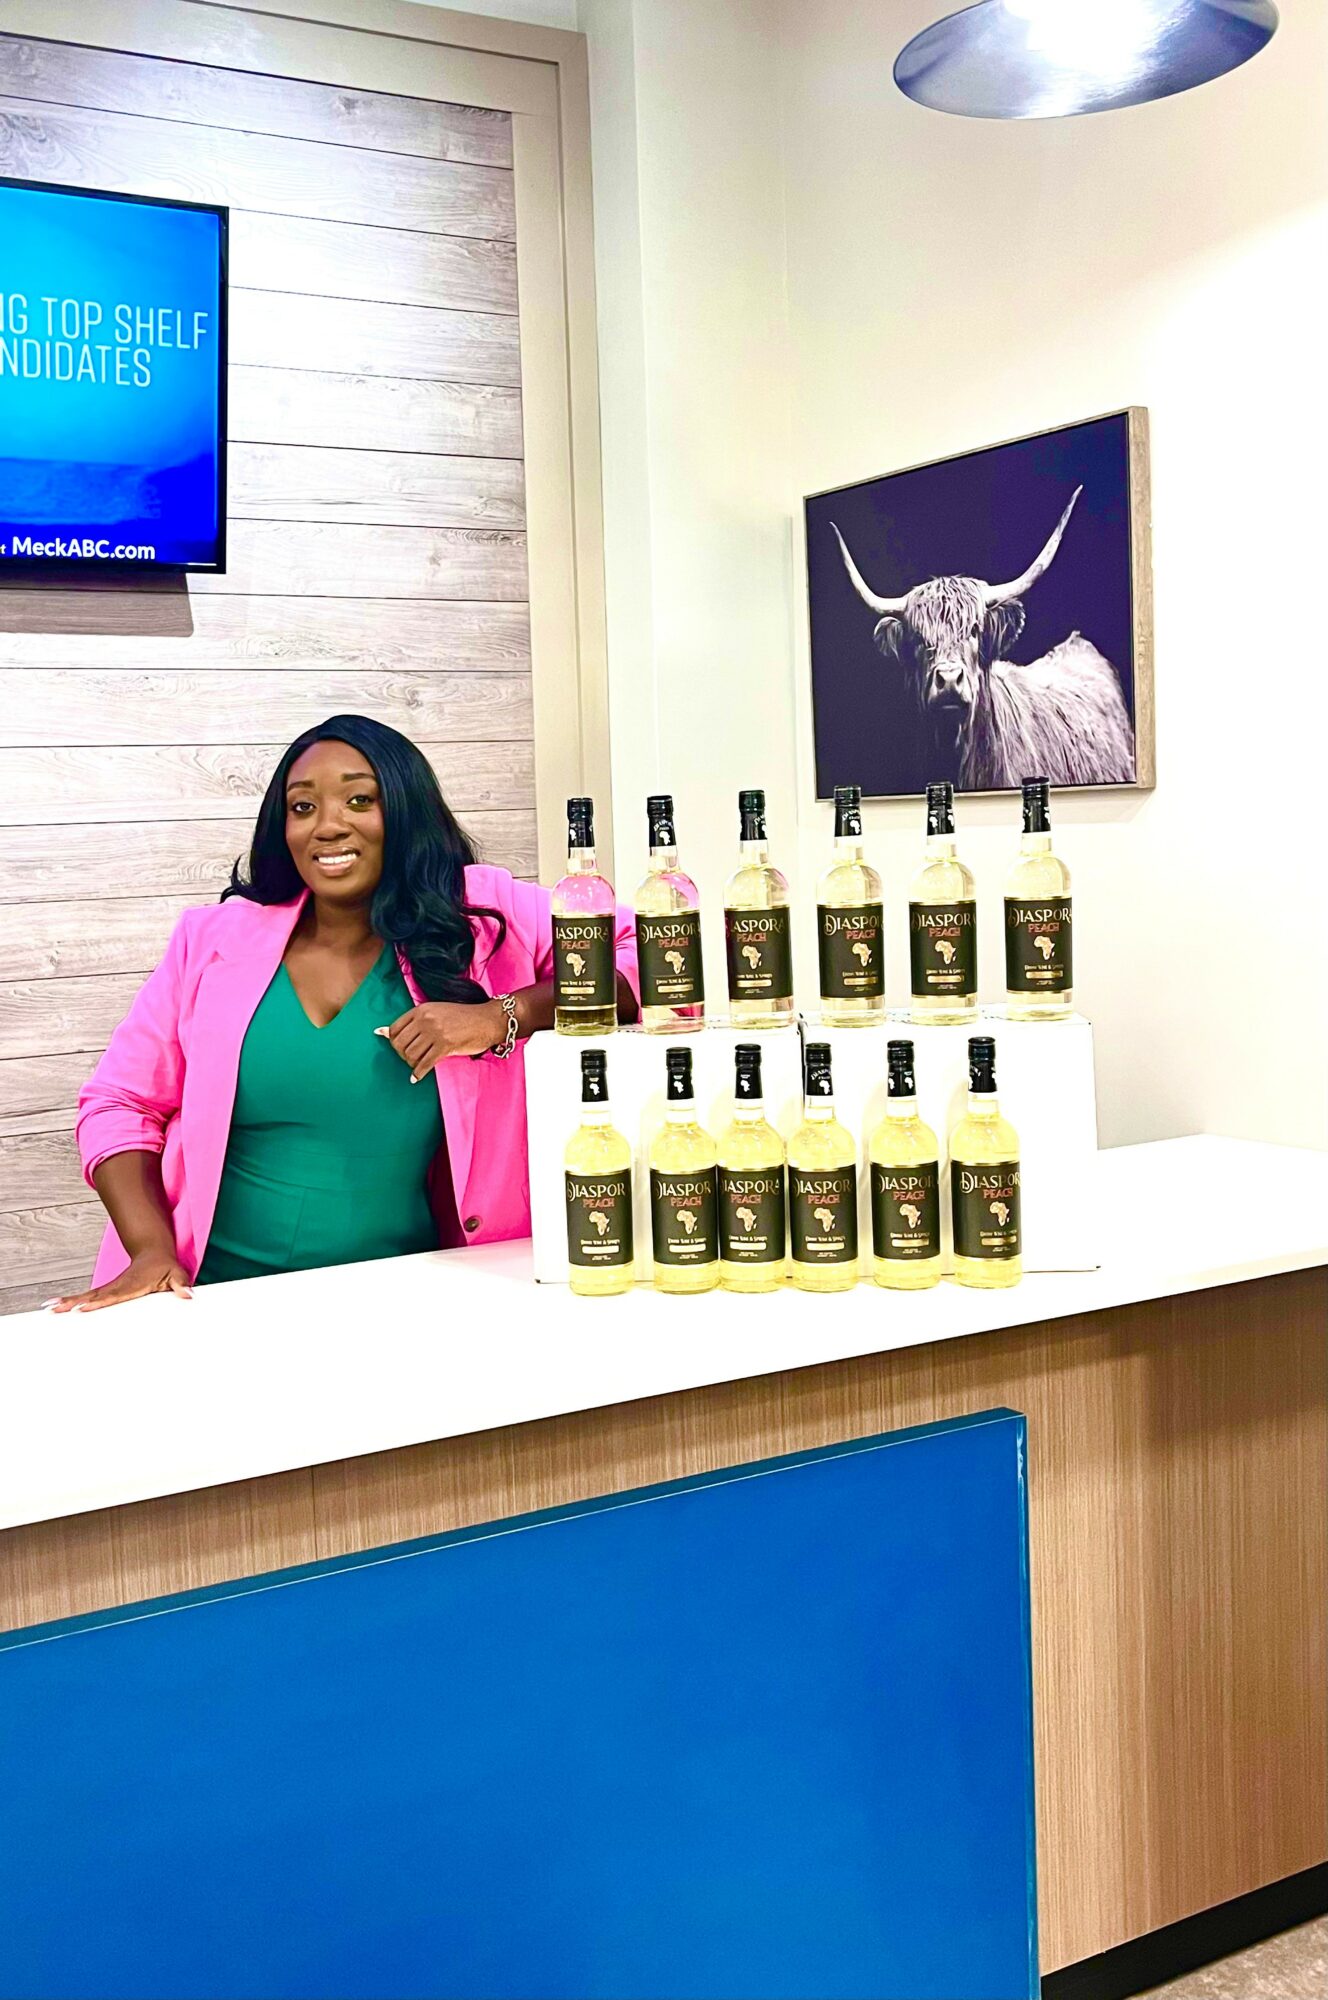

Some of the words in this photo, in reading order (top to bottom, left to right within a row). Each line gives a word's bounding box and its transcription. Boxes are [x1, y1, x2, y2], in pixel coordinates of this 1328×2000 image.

[40, 296, 103, 340] TOP
[114, 303, 209, 350] SHELF
[0, 336, 152, 388] NDIDATES
[12, 536, 156, 560] MeckABC.com
[927, 926, 961, 938] PEACH
[1027, 921, 1060, 933] PEACH
[555, 926, 608, 942] IASPORA
[736, 931, 767, 943] PEACH
[844, 927, 877, 940] PEACH
[561, 940, 591, 951] PEACH
[657, 937, 689, 948] PEACH
[722, 1179, 780, 1196] IASPORA
[669, 1195, 703, 1207] PEACH
[730, 1192, 762, 1204] PEACH
[807, 1193, 841, 1205] PEACH
[892, 1189, 926, 1201] PEACH
[582, 1197, 616, 1208] PEACH
